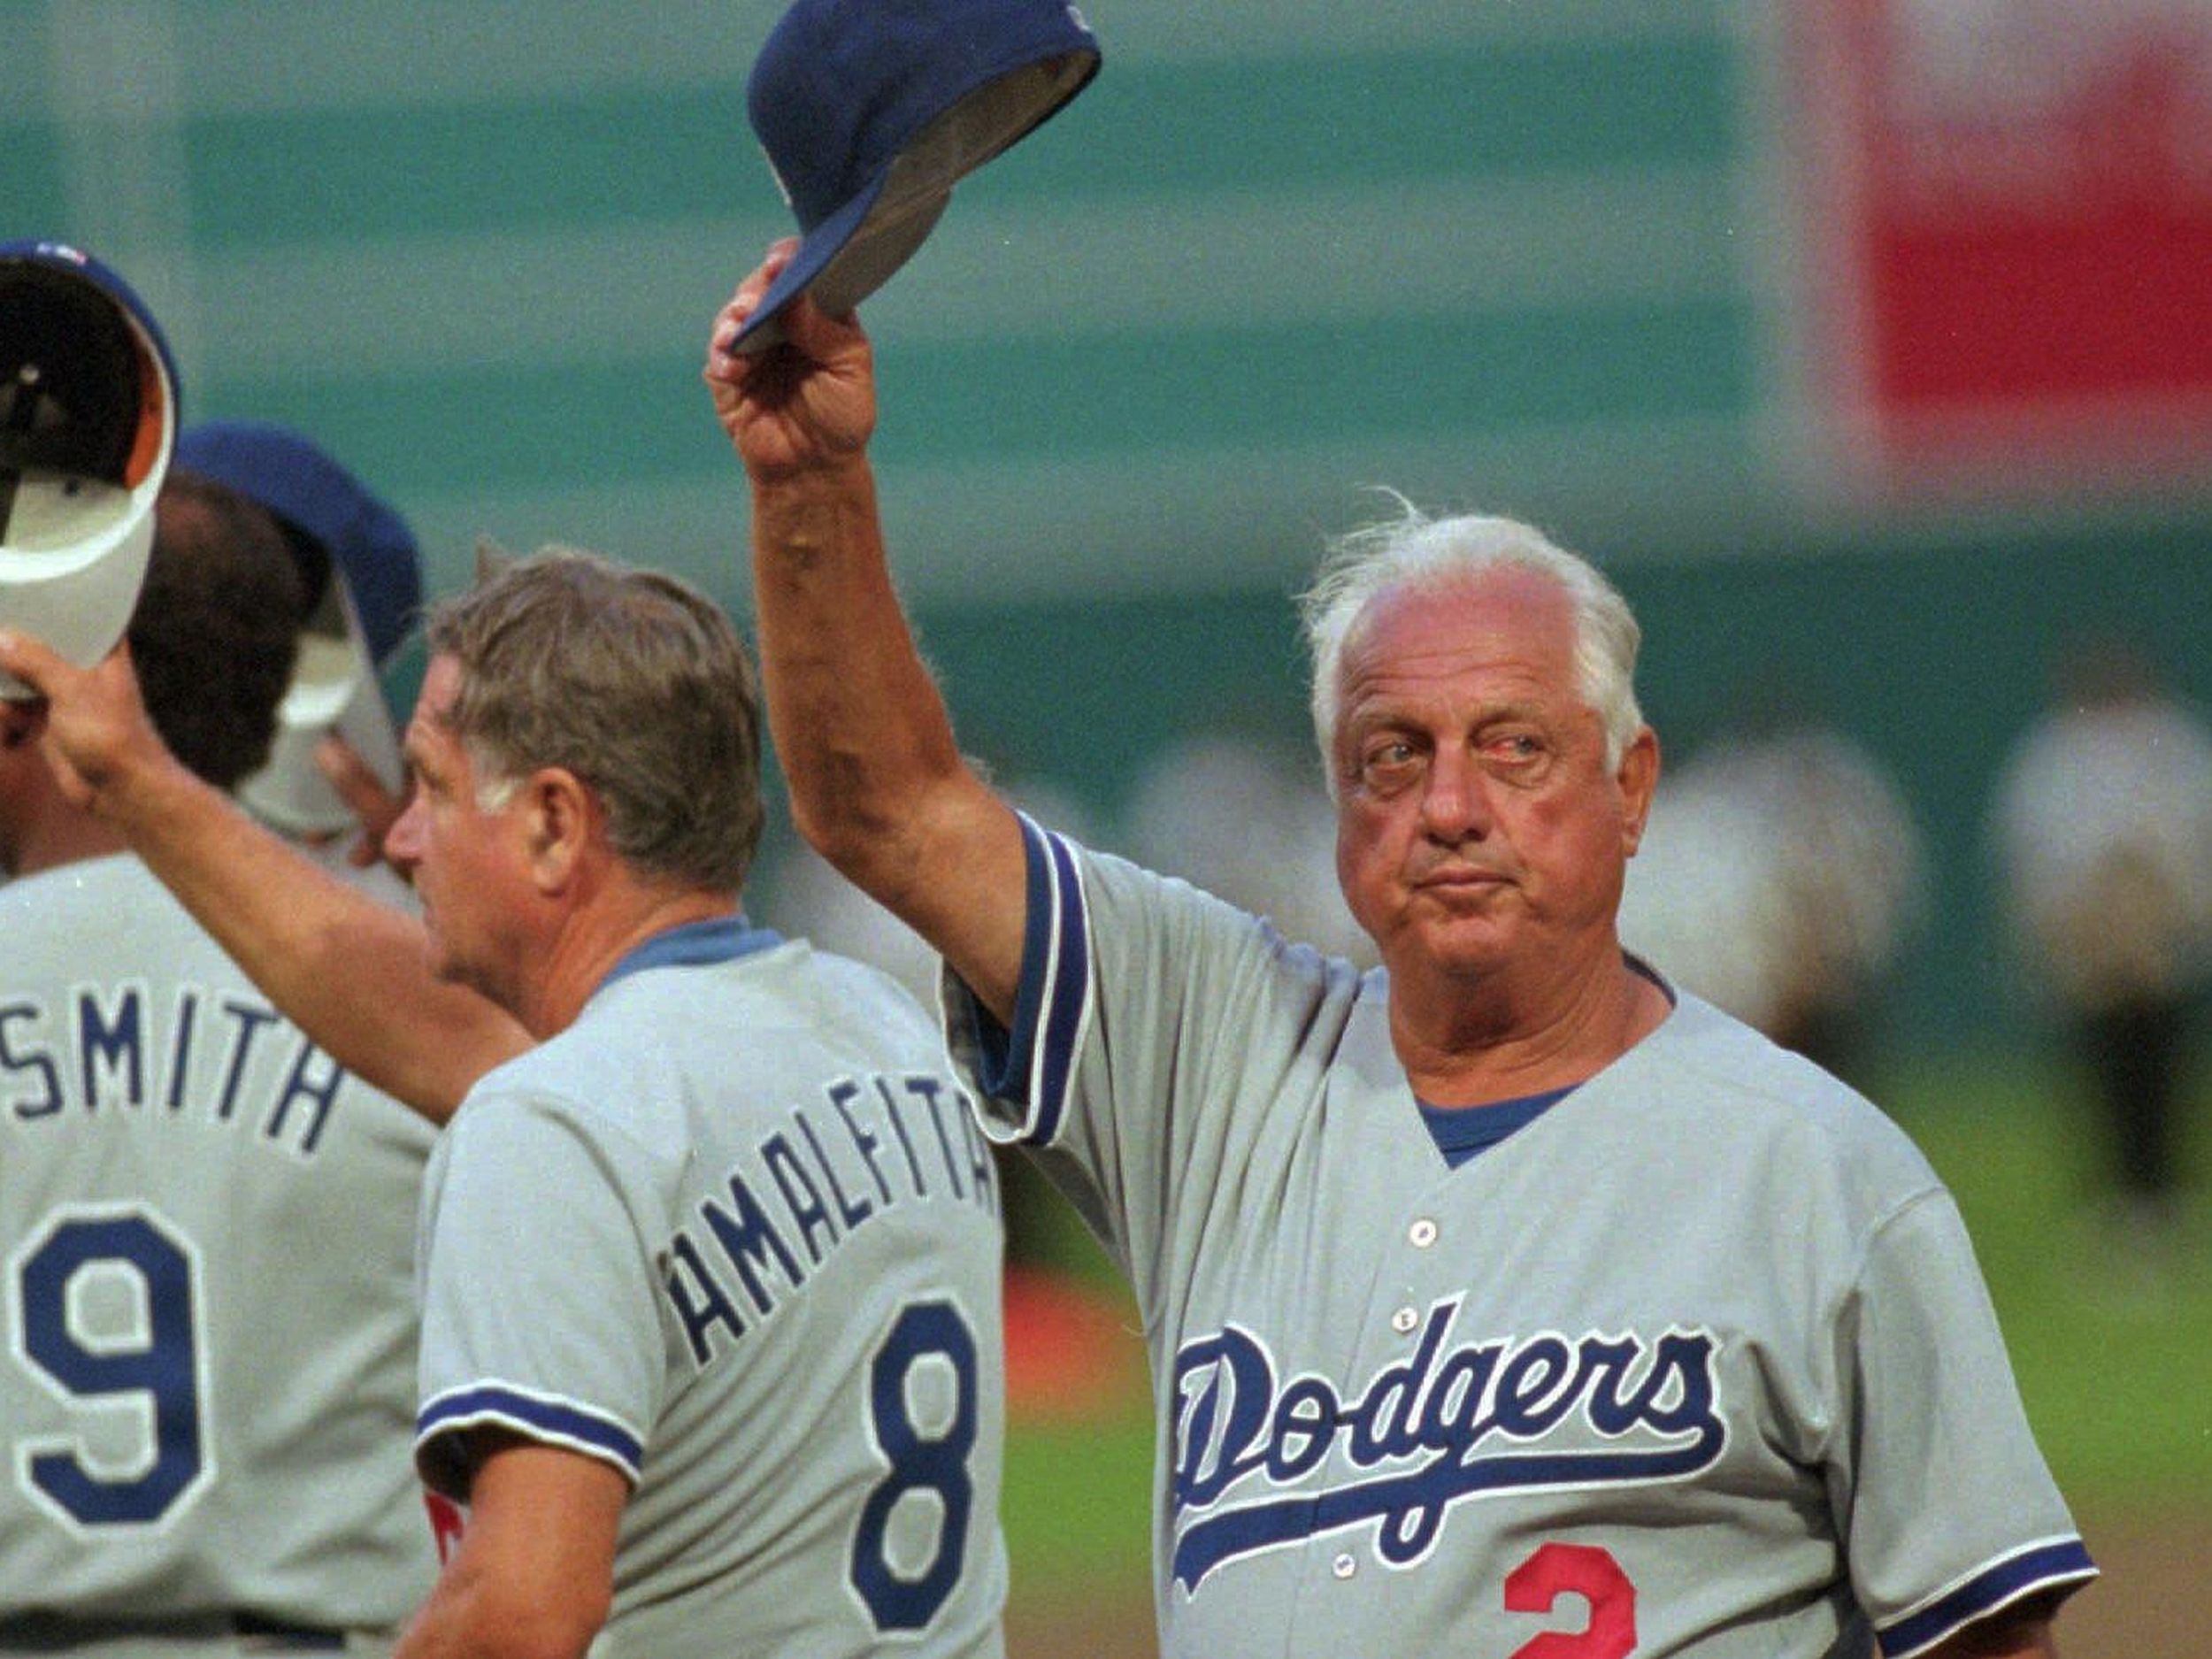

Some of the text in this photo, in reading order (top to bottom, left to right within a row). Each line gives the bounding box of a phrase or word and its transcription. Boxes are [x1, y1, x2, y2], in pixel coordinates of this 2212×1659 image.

[0, 984, 347, 1154] SMITH
[18, 1212, 207, 1527] 9
[849, 1297, 979, 1633] 8
[1172, 1290, 1727, 1595] Dodgers
[1502, 1541, 1639, 1659] 2
